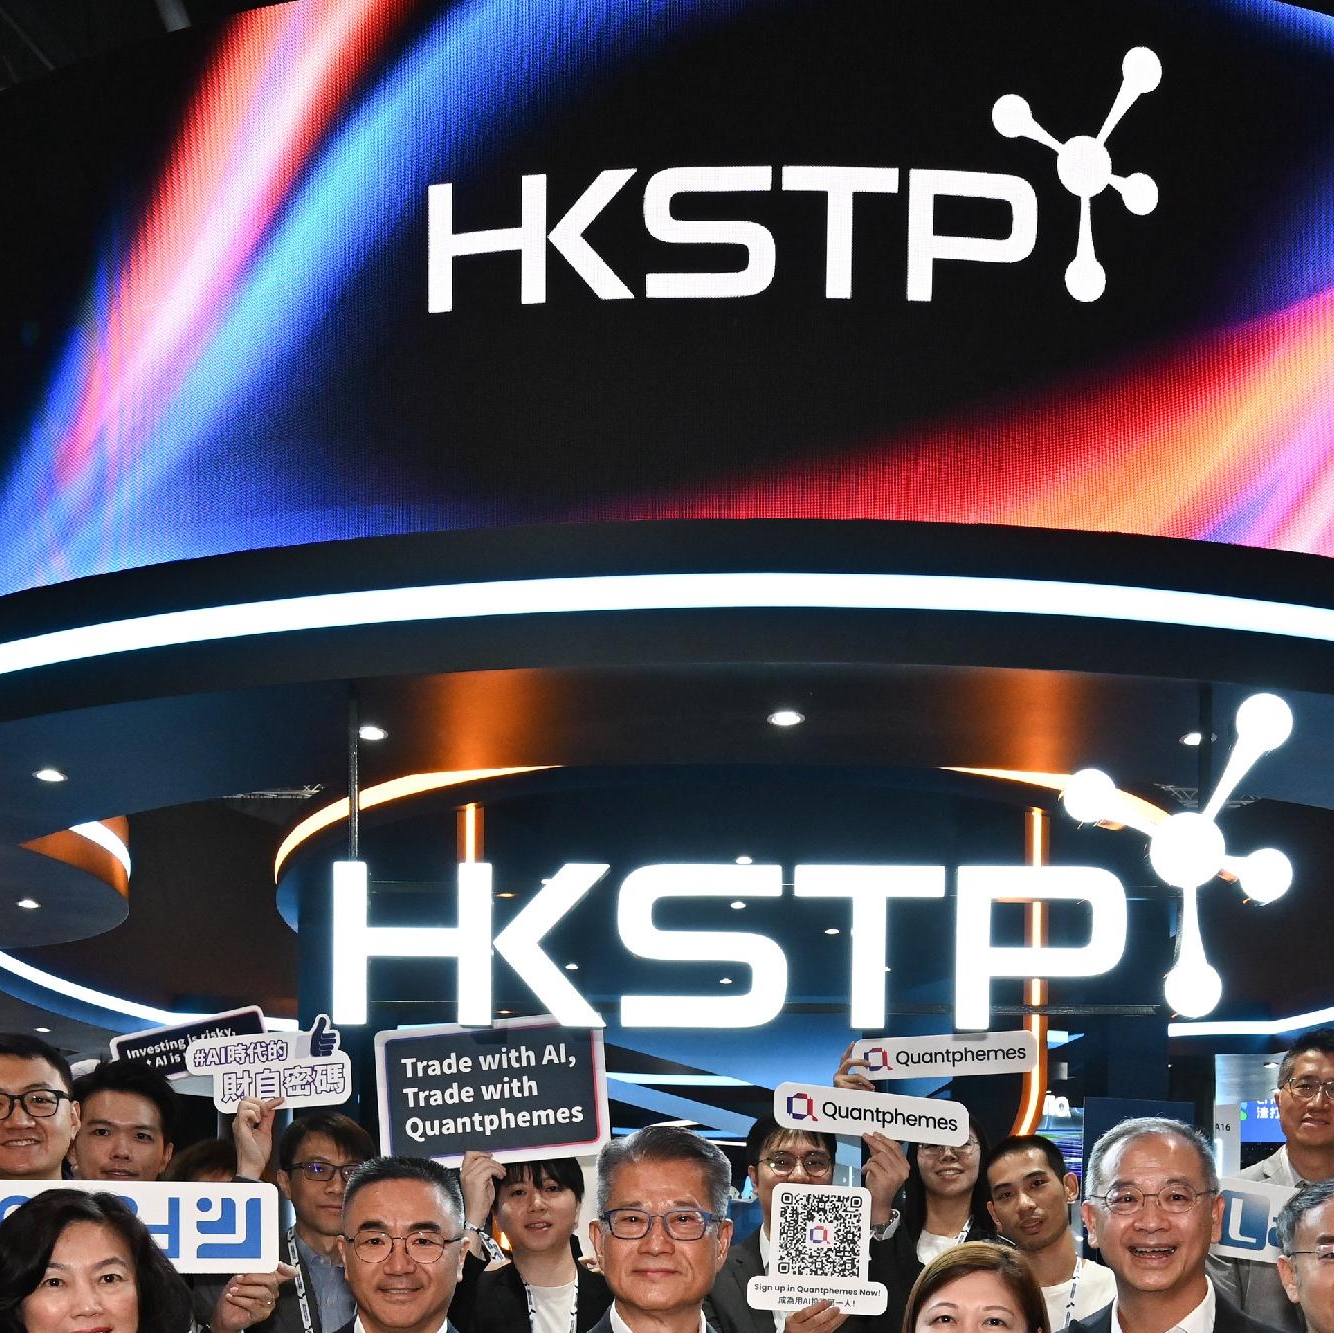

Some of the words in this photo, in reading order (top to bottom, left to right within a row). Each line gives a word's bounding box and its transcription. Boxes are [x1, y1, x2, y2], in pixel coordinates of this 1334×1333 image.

[427, 165, 1038, 314] HKSTP
[332, 861, 1128, 1030] HKSTP
[126, 1037, 187, 1060] Investing
[155, 1055, 168, 1068] AI
[170, 1052, 181, 1064] is
[193, 1039, 289, 1068] #AI時代的
[401, 1052, 473, 1079] Trade
[479, 1045, 536, 1071] with
[541, 1042, 577, 1068] AI,
[895, 1046, 1027, 1068] Quantphemes
[403, 1082, 475, 1108] Trade
[480, 1075, 539, 1101] with
[405, 1104, 585, 1142] Quantphemes
[822, 1101, 958, 1133] Quantphemes
[754, 1283, 773, 1293] Sign
[774, 1285, 786, 1293] up
[787, 1284, 795, 1292] in
[797, 1285, 858, 1296] Quantphemes
[859, 1289, 881, 1297] Now!
